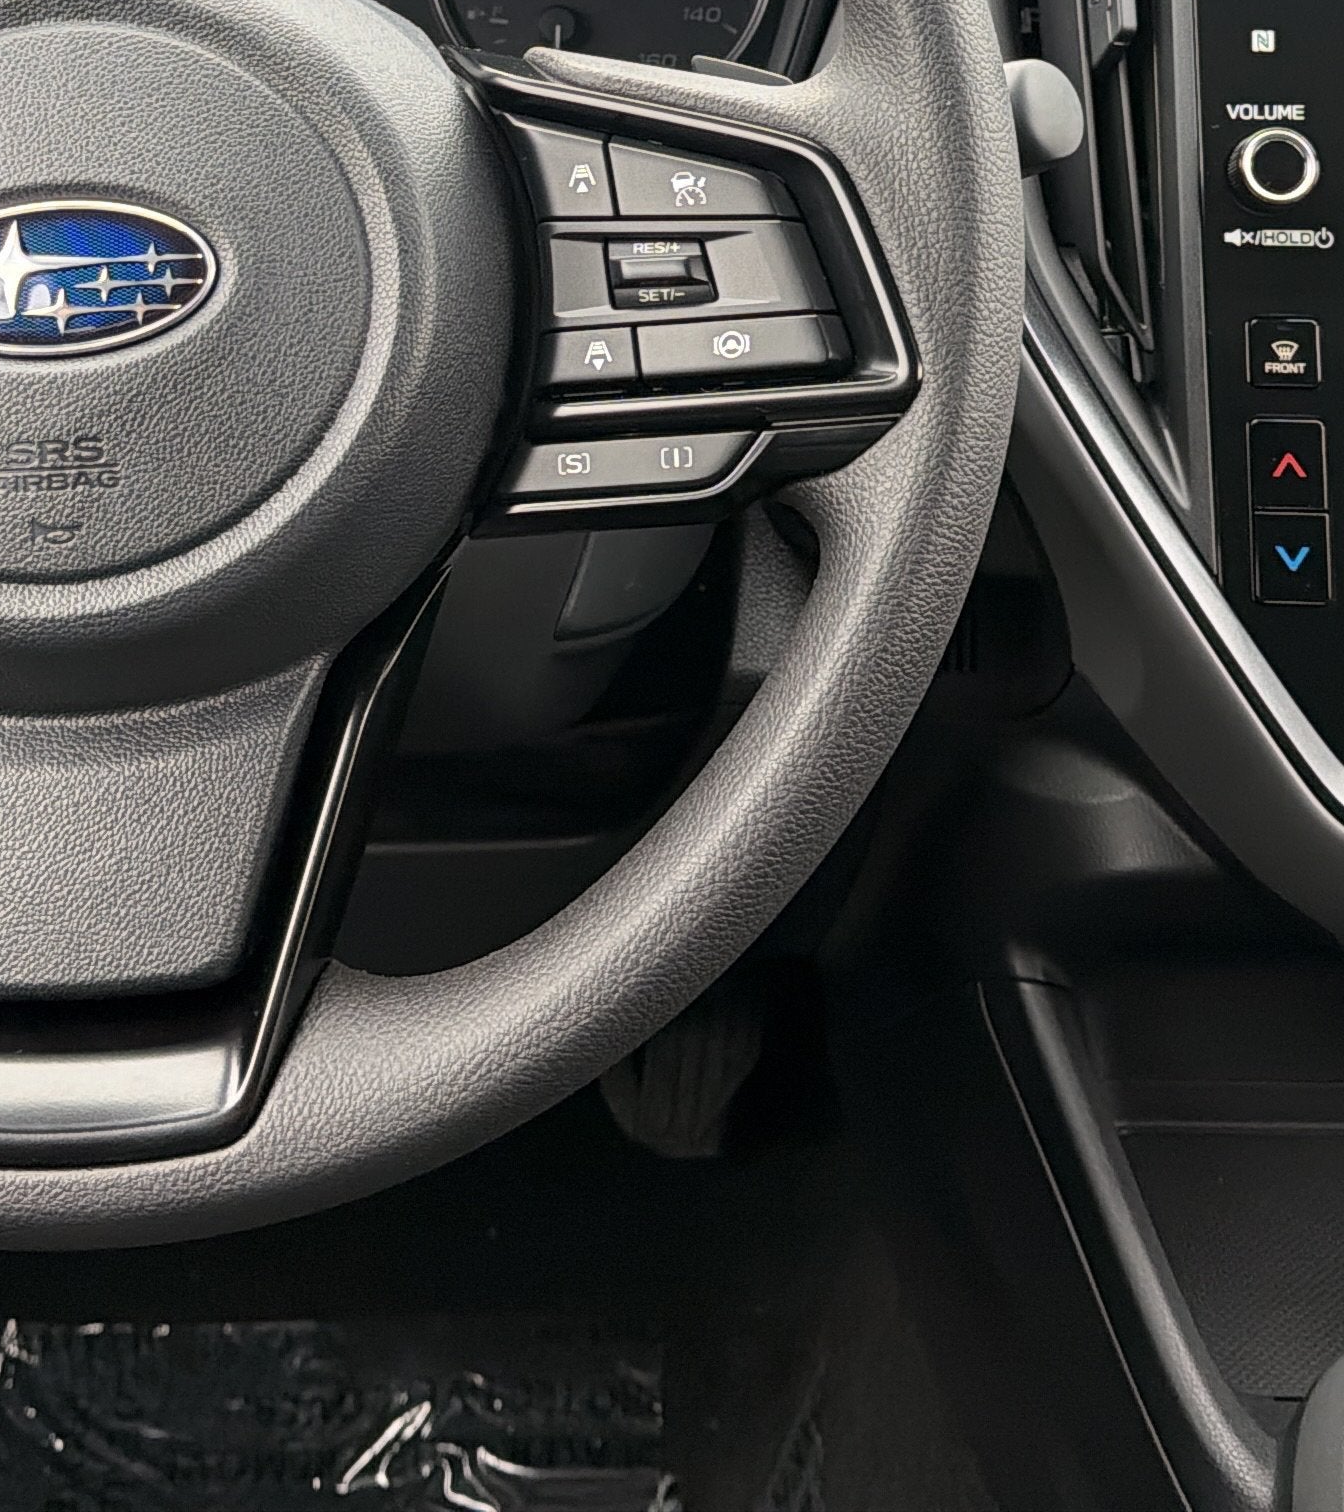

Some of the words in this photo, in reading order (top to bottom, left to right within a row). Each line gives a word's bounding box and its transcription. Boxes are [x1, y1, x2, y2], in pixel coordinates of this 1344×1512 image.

[682, 6, 722, 24] 140
[1226, 103, 1306, 121] VOLUME
[1263, 230, 1313, 246] HOLD
[1264, 362, 1307, 375] FRONT
[5, 439, 105, 466] SRS
